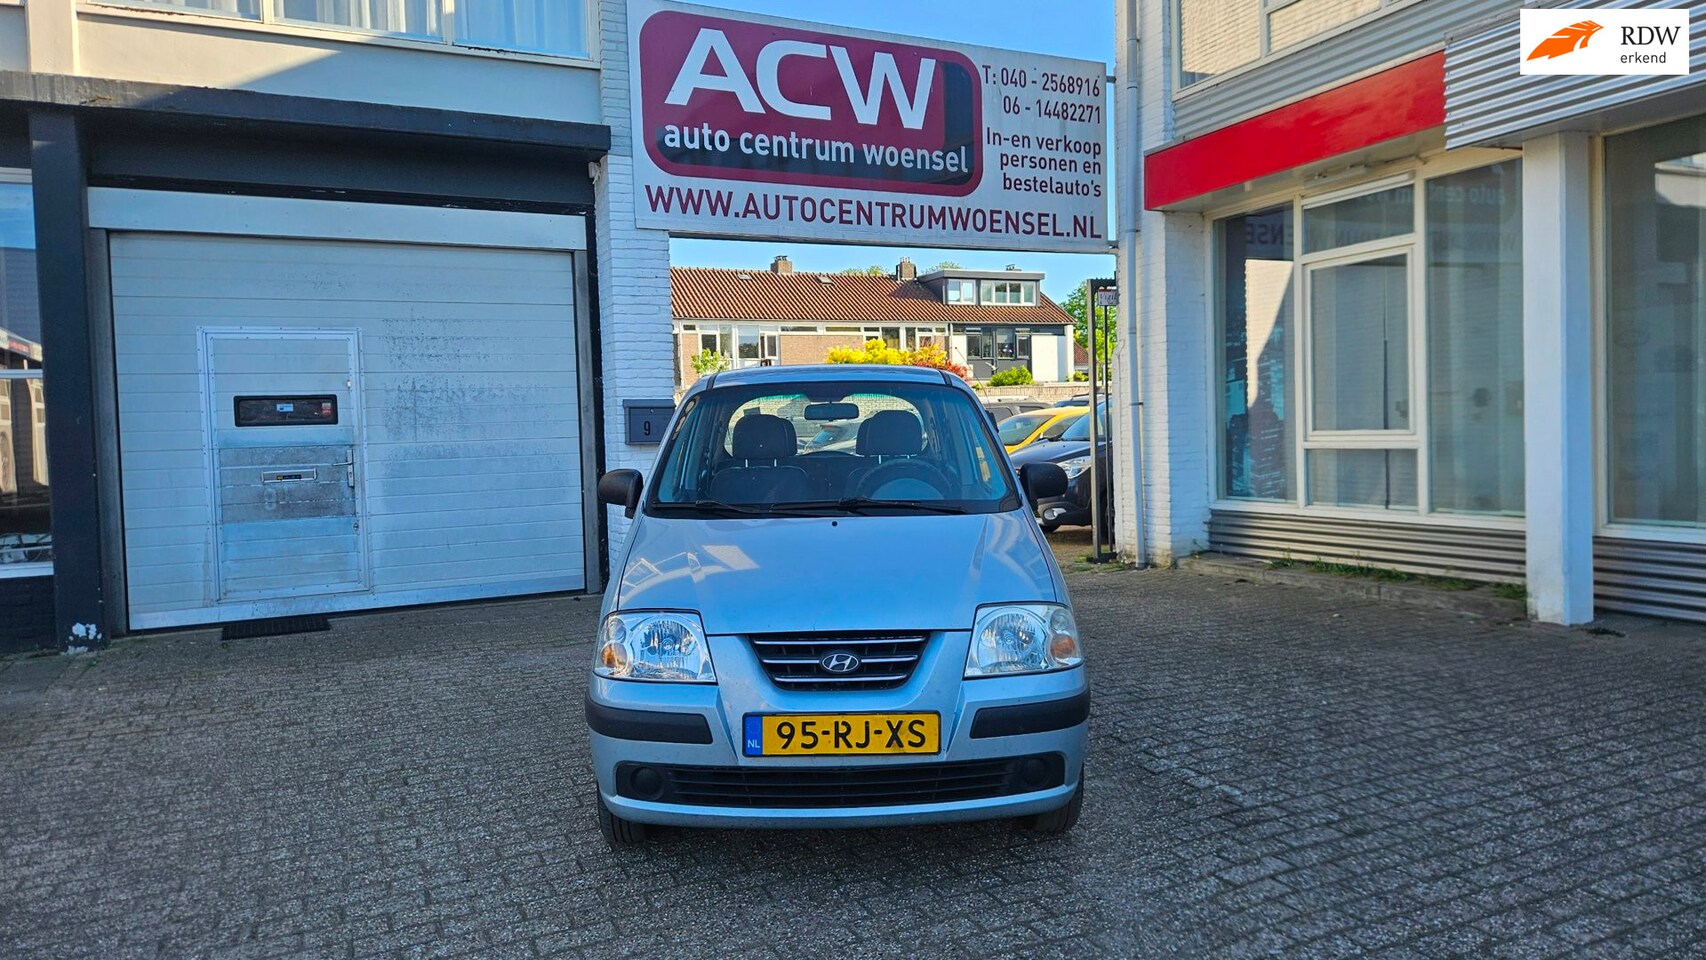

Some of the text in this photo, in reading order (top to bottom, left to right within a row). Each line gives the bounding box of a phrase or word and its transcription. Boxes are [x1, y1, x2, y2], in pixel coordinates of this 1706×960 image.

[664, 27, 937, 130] ACW
[982, 64, 997, 85] T:
[1001, 67, 1027, 89] 040
[1041, 72, 1101, 98] 2568916
[1003, 95, 1021, 115] 06
[1036, 98, 1101, 125] 14482271
[664, 122, 969, 174] auto centrum woensel
[986, 127, 1102, 160] In-en verkoop
[1000, 152, 1102, 175] personen en
[1003, 172, 1102, 198] bestelauto's
[644, 184, 1103, 240] WWW.AUTOCENTRUMWOENSEL.NL
[643, 420, 651, 437] 9
[747, 719, 926, 750] NL 95-RJ-XS
